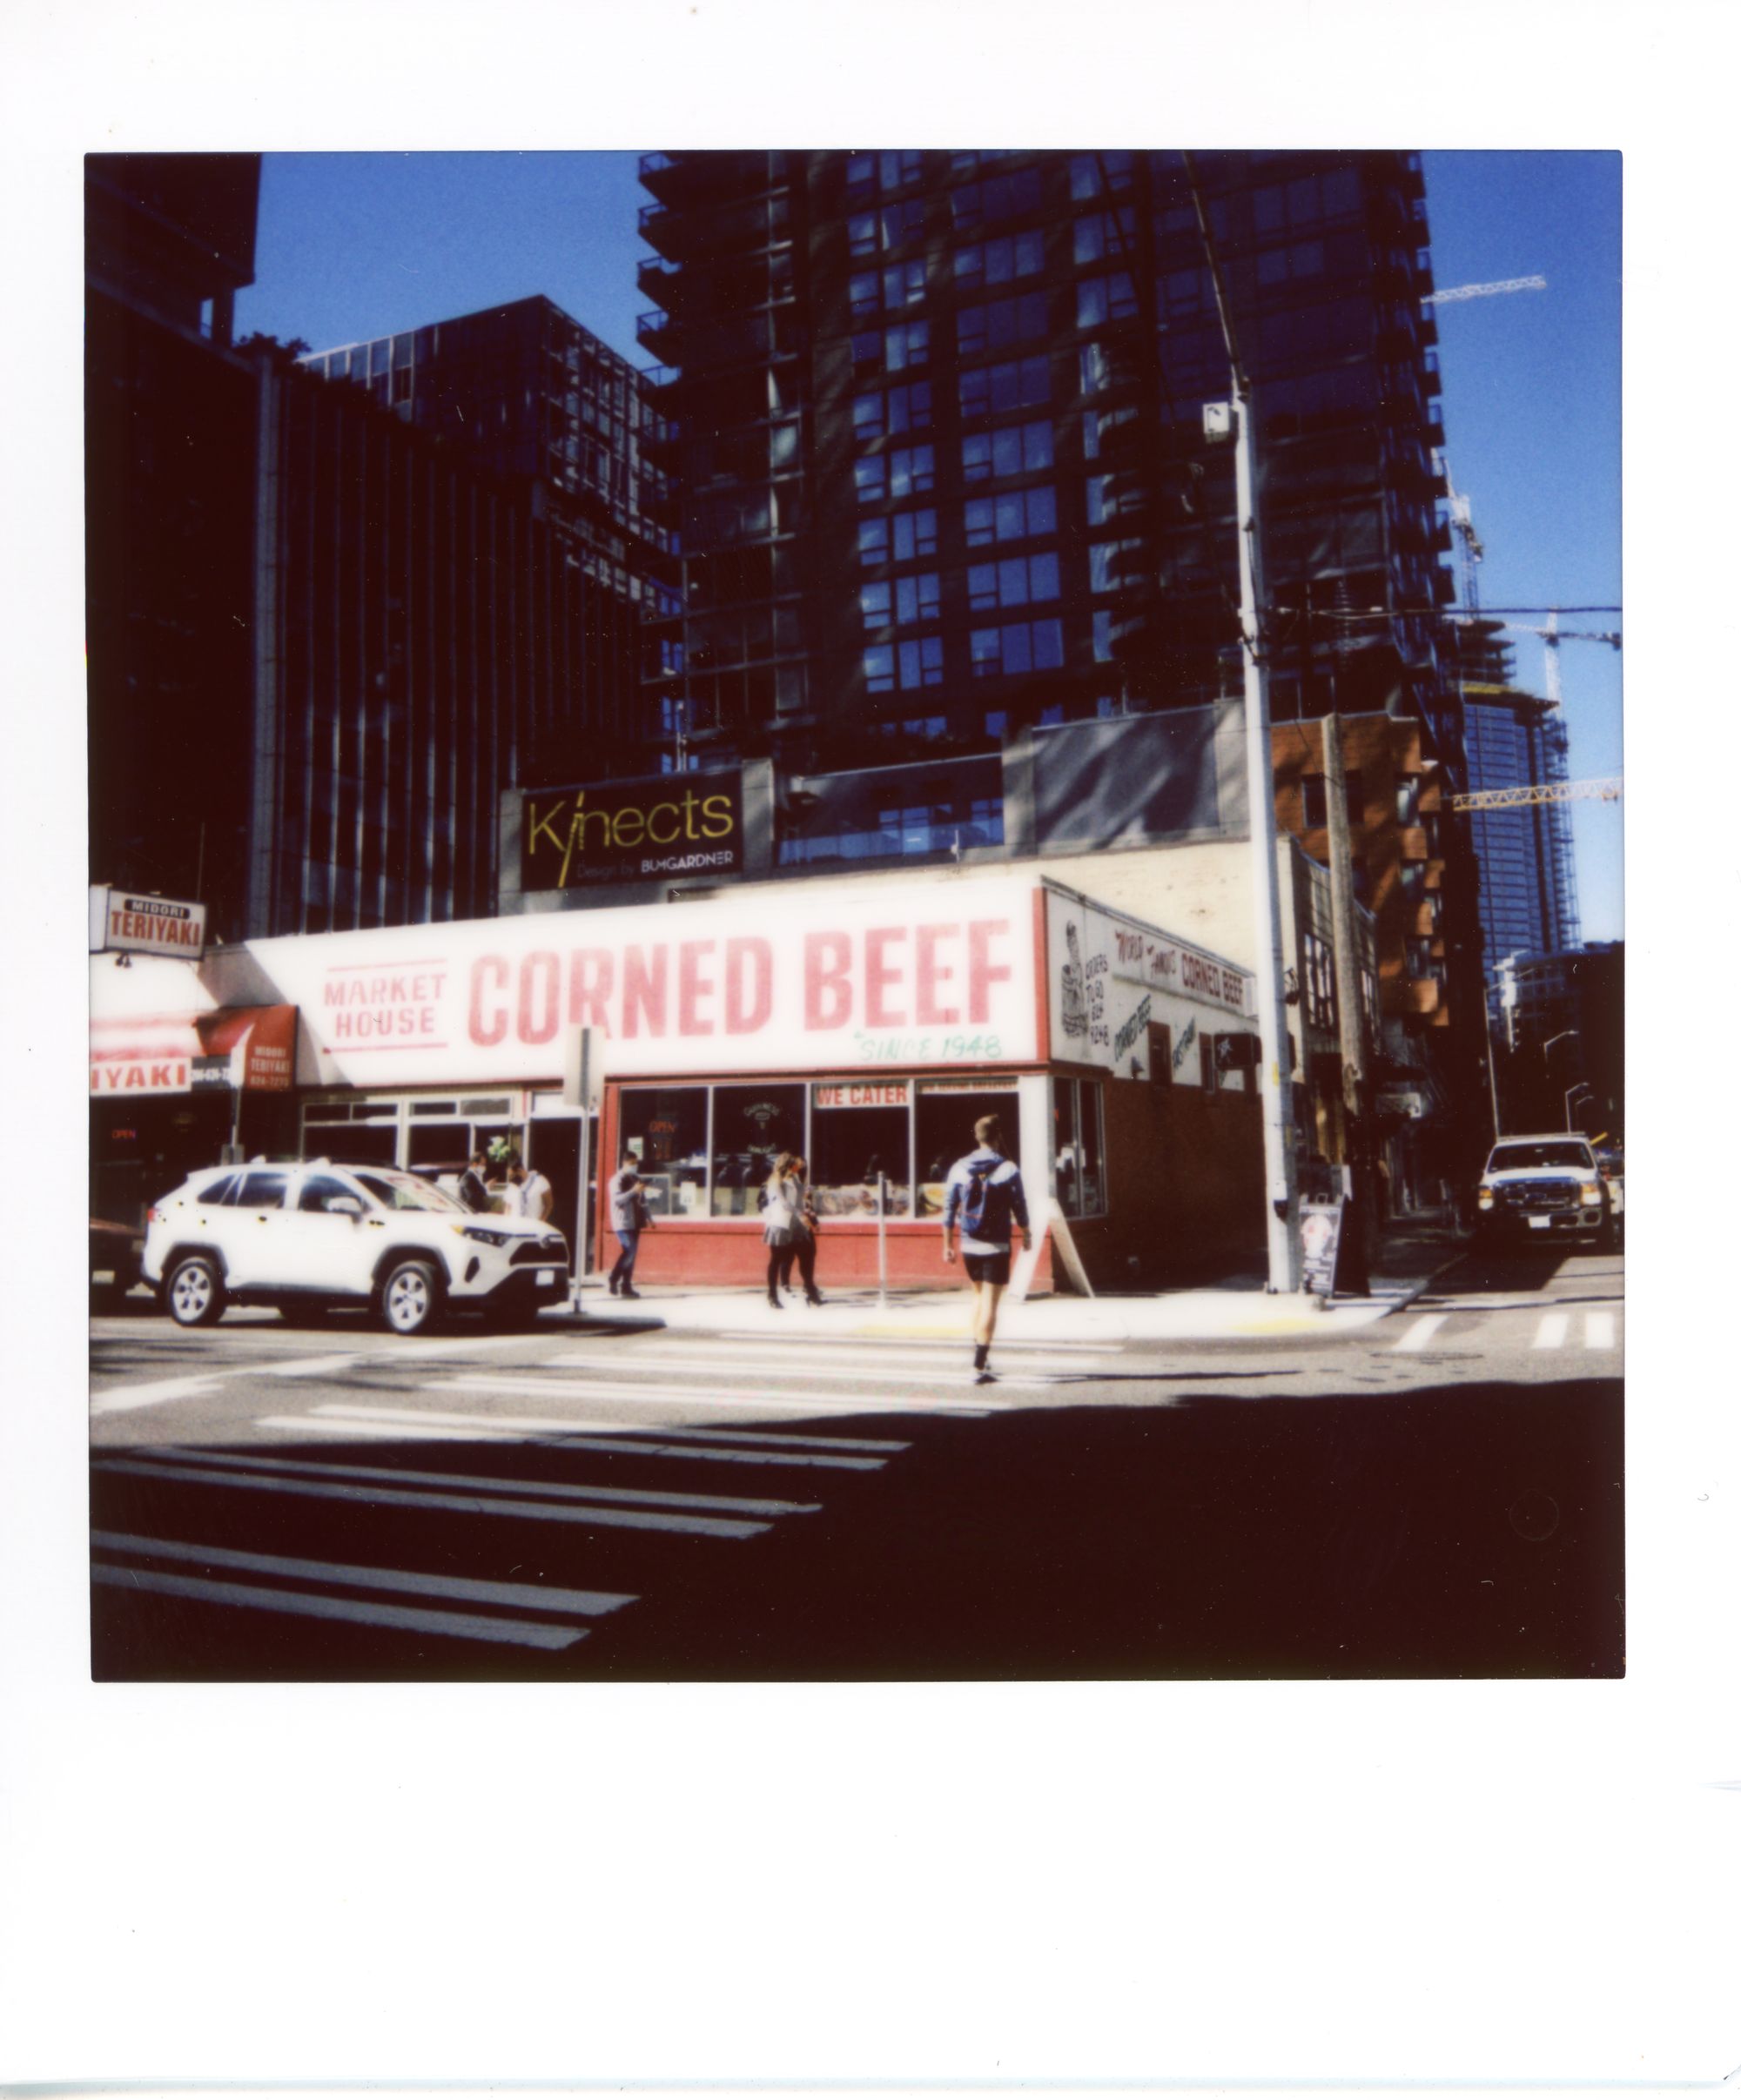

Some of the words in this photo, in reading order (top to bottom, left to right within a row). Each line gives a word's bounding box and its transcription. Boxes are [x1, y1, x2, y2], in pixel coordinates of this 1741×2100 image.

[642, 850, 733, 873] BUMGARDNER
[131, 900, 185, 917] MIDORI
[111, 910, 201, 948] TERIYAKI
[467, 936, 774, 1046] CORNED
[803, 919, 1011, 1031] BEEF
[1181, 952, 1220, 998] CORNED
[1222, 969, 1243, 1004] BEEF
[323, 973, 446, 1007] MARKET
[335, 1007, 436, 1038] HOUSE
[250, 1058, 289, 1073] TERIYAKI
[817, 1085, 844, 1106] WE
[850, 1084, 907, 1105] CATER
[111, 1130, 136, 1139] OPEN
[649, 1120, 676, 1133] OPEN
